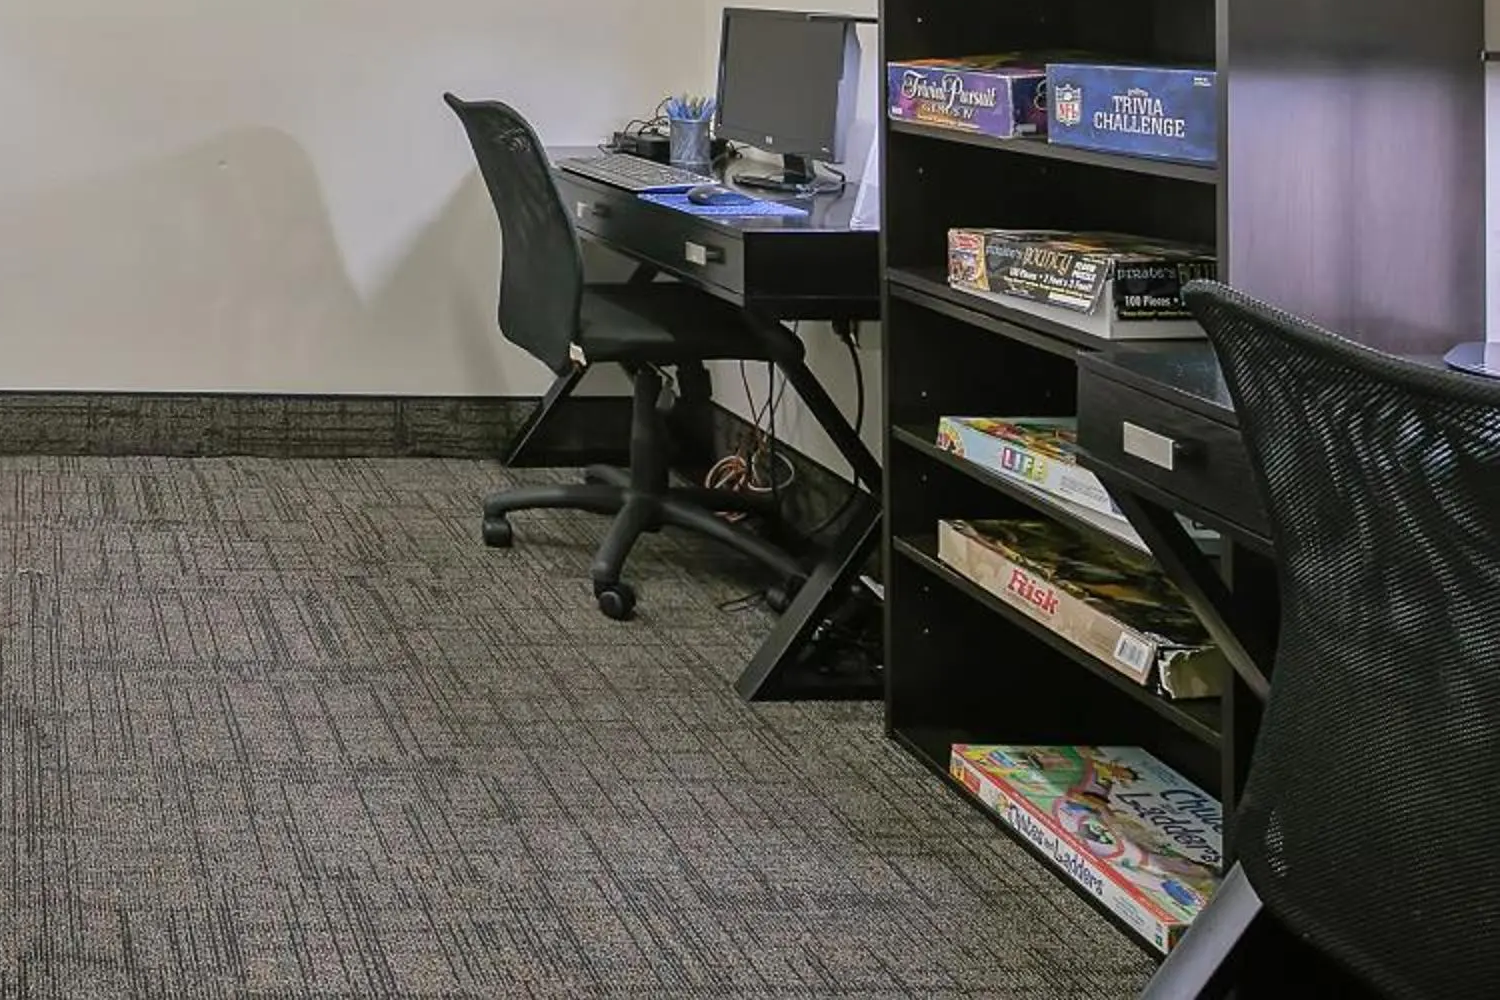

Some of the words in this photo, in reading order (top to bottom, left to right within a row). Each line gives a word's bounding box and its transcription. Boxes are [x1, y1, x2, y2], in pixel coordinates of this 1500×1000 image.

[1058, 103, 1080, 119] NFL
[1112, 96, 1164, 115] TRIVIA
[1094, 111, 1186, 138] CHALLENGE
[999, 446, 1048, 483] LIFE
[1008, 567, 1060, 615] Risk
[1053, 841, 1104, 898] Ladders
